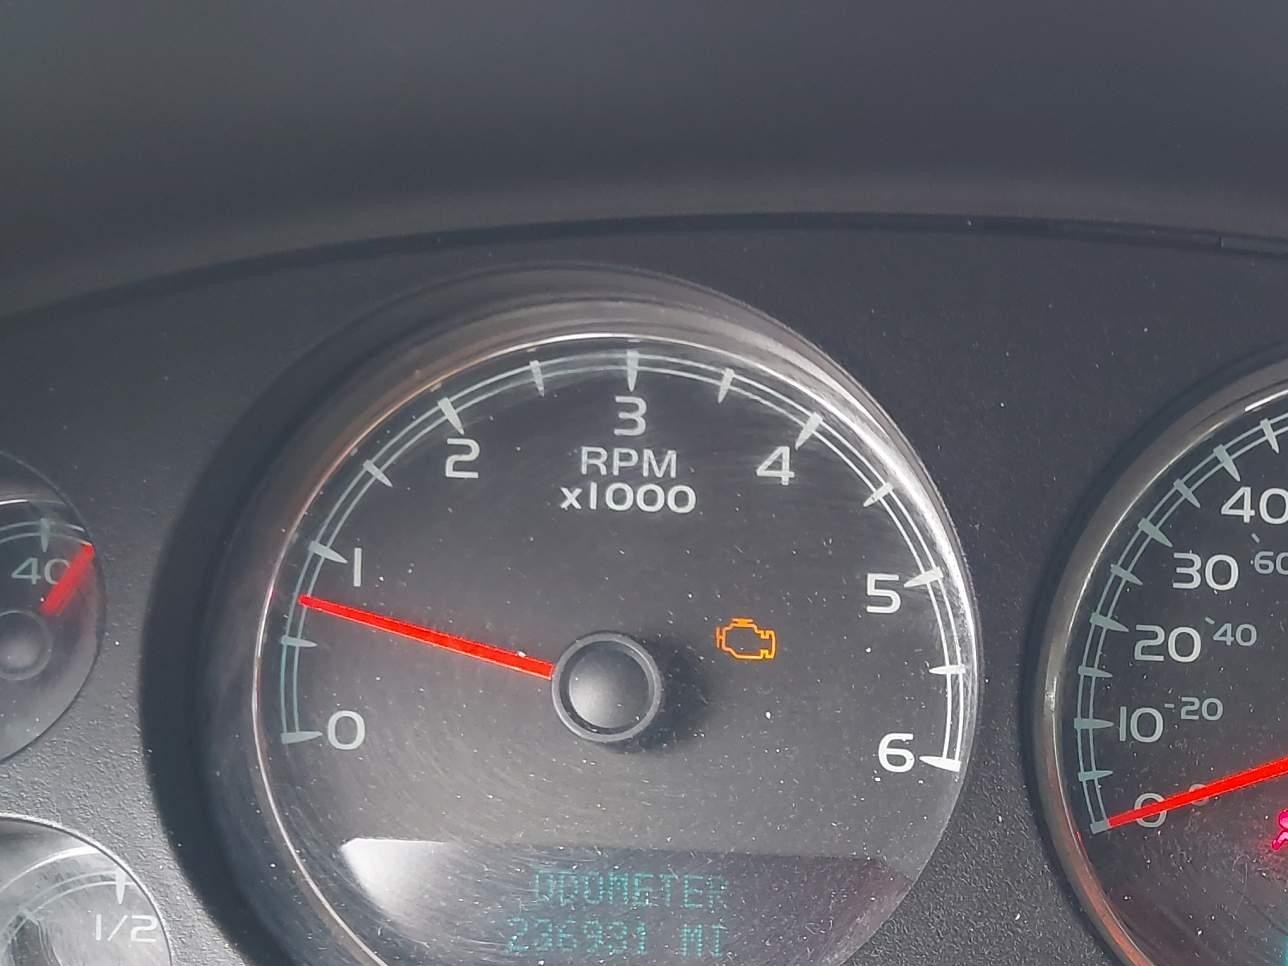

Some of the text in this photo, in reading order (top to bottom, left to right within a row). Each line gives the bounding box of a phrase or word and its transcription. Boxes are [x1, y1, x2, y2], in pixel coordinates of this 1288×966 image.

[614, 396, 648, 438] 3
[445, 438, 480, 478] 2
[580, 446, 677, 478] RPM
[756, 446, 795, 486] 4
[560, 484, 697, 514] x1000
[352, 546, 363, 588] 1
[1172, 552, 1239, 591] 30
[866, 572, 900, 615] 5
[1134, 625, 1202, 663] 20
[1212, 623, 1258, 648] 40
[1119, 706, 1164, 743] 10
[1180, 697, 1224, 721] 20
[327, 709, 366, 751] 0
[877, 732, 916, 774] 6
[95, 914, 156, 942] 1/2
